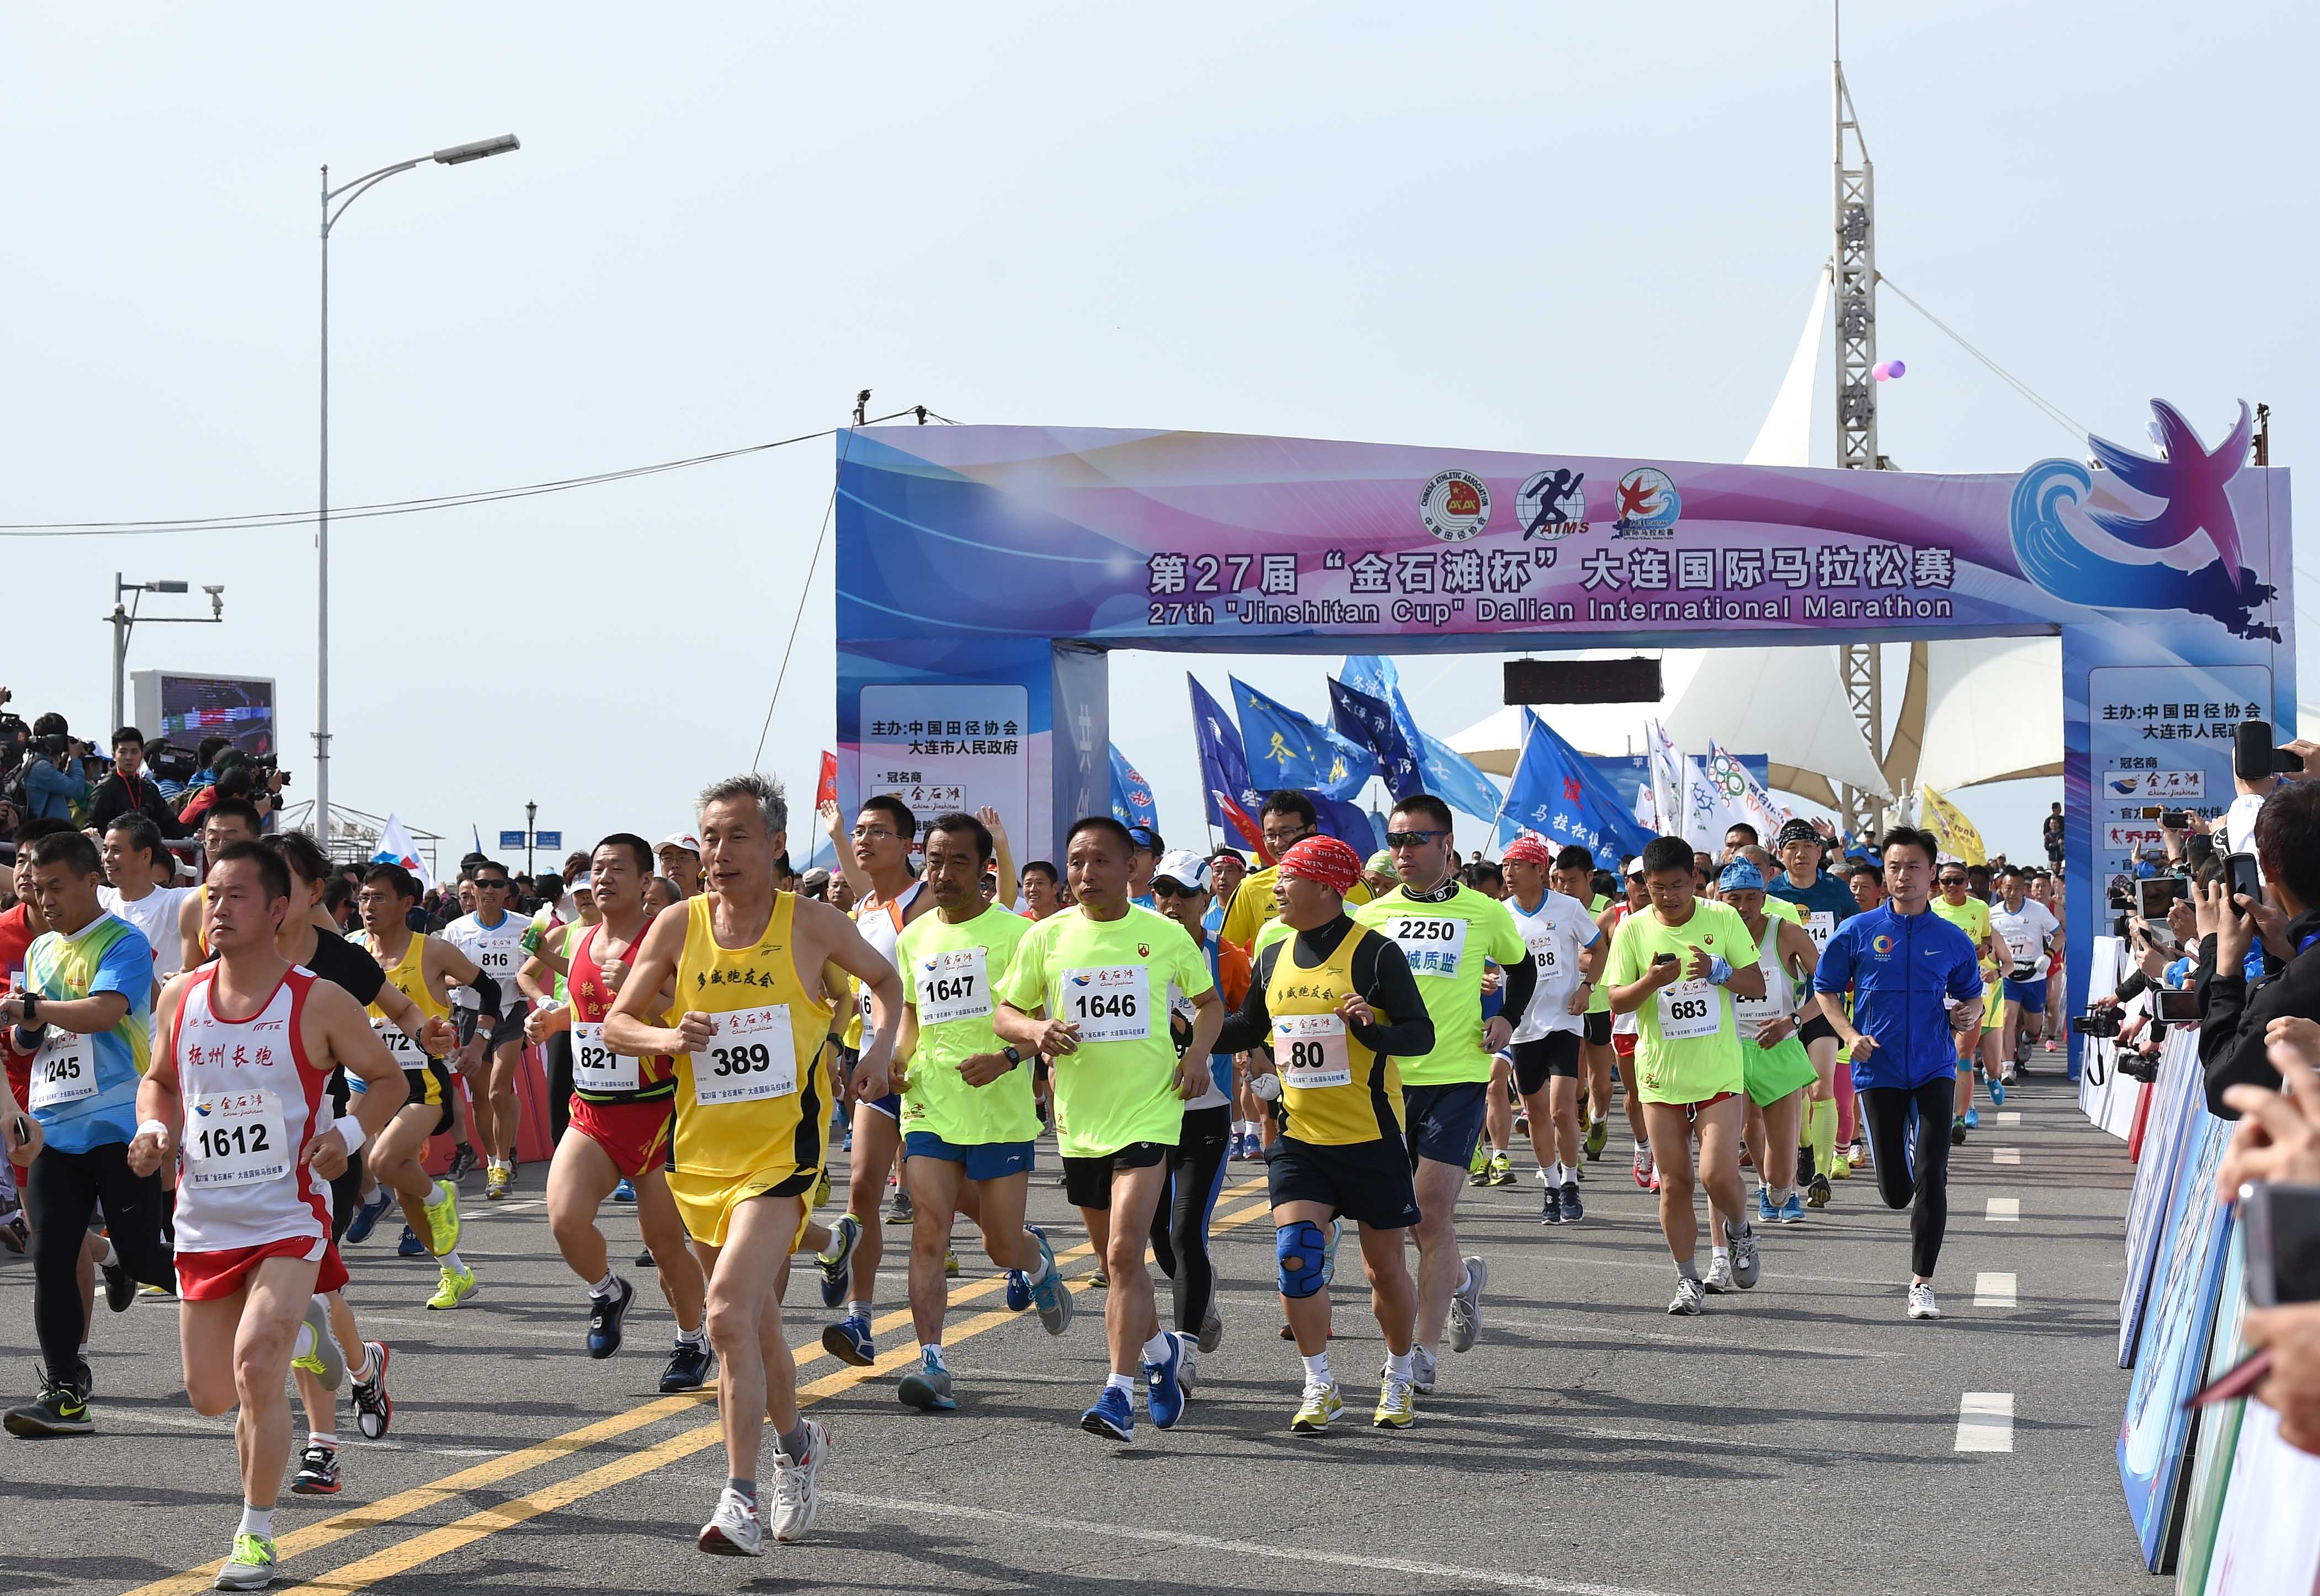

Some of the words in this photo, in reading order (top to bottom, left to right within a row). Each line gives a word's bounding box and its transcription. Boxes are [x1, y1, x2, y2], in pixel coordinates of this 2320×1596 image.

[1421, 481, 1436, 507] CHINESE
[1435, 471, 1461, 487] ATHLETIC
[1462, 474, 1489, 507] ASSOCIATION
[1424, 516, 1487, 540] 中国田径协会
[1540, 522, 1590, 534] AIMS
[1148, 553, 1297, 595] 第27届
[1324, 547, 1557, 594] “金石滩杯”
[1582, 547, 1956, 590] 大连国际马拉松赛
[1148, 599, 1214, 625] 27th
[1225, 599, 1380, 625] "Jinshitan
[1392, 599, 1464, 627] Cup"
[1477, 598, 1574, 624] Dalian
[1588, 597, 1789, 620] International
[1804, 594, 1951, 619] Marathon
[2143, 723, 2236, 740] 大连市人民
[908, 740, 1018, 756] 大连市人民政府
[2120, 757, 2158, 769] 冠名商
[886, 772, 922, 784] 冠名商
[2147, 773, 2199, 788] 金石滩
[911, 785, 960, 802] 金石滩
[1398, 921, 1455, 941] 2250
[482, 954, 508, 966] 816
[944, 953, 973, 965] 金石滩
[697, 967, 775, 992] 多威跑友会
[1099, 969, 1134, 981] 金石滩
[926, 975, 975, 1002] 1647
[1278, 985, 1334, 1004] 多威跑友会
[1076, 994, 1136, 1018] 1646
[1671, 999, 1707, 1020] 683
[729, 1011, 773, 1028] 金石滩
[1110, 1028, 1145, 1036] 大连国际马拉松赛
[189, 1044, 273, 1068] 抚州长跑
[581, 1047, 617, 1070] 821
[711, 1043, 770, 1077] 389
[1292, 1041, 1324, 1068] 80
[44, 1056, 80, 1083] 1245
[748, 1081, 791, 1095] 大连国际马拉松赛
[221, 1094, 263, 1110] 金石滩
[200, 1124, 269, 1158] 1612
[238, 1166, 283, 1179] 大连国际马拉松赛
